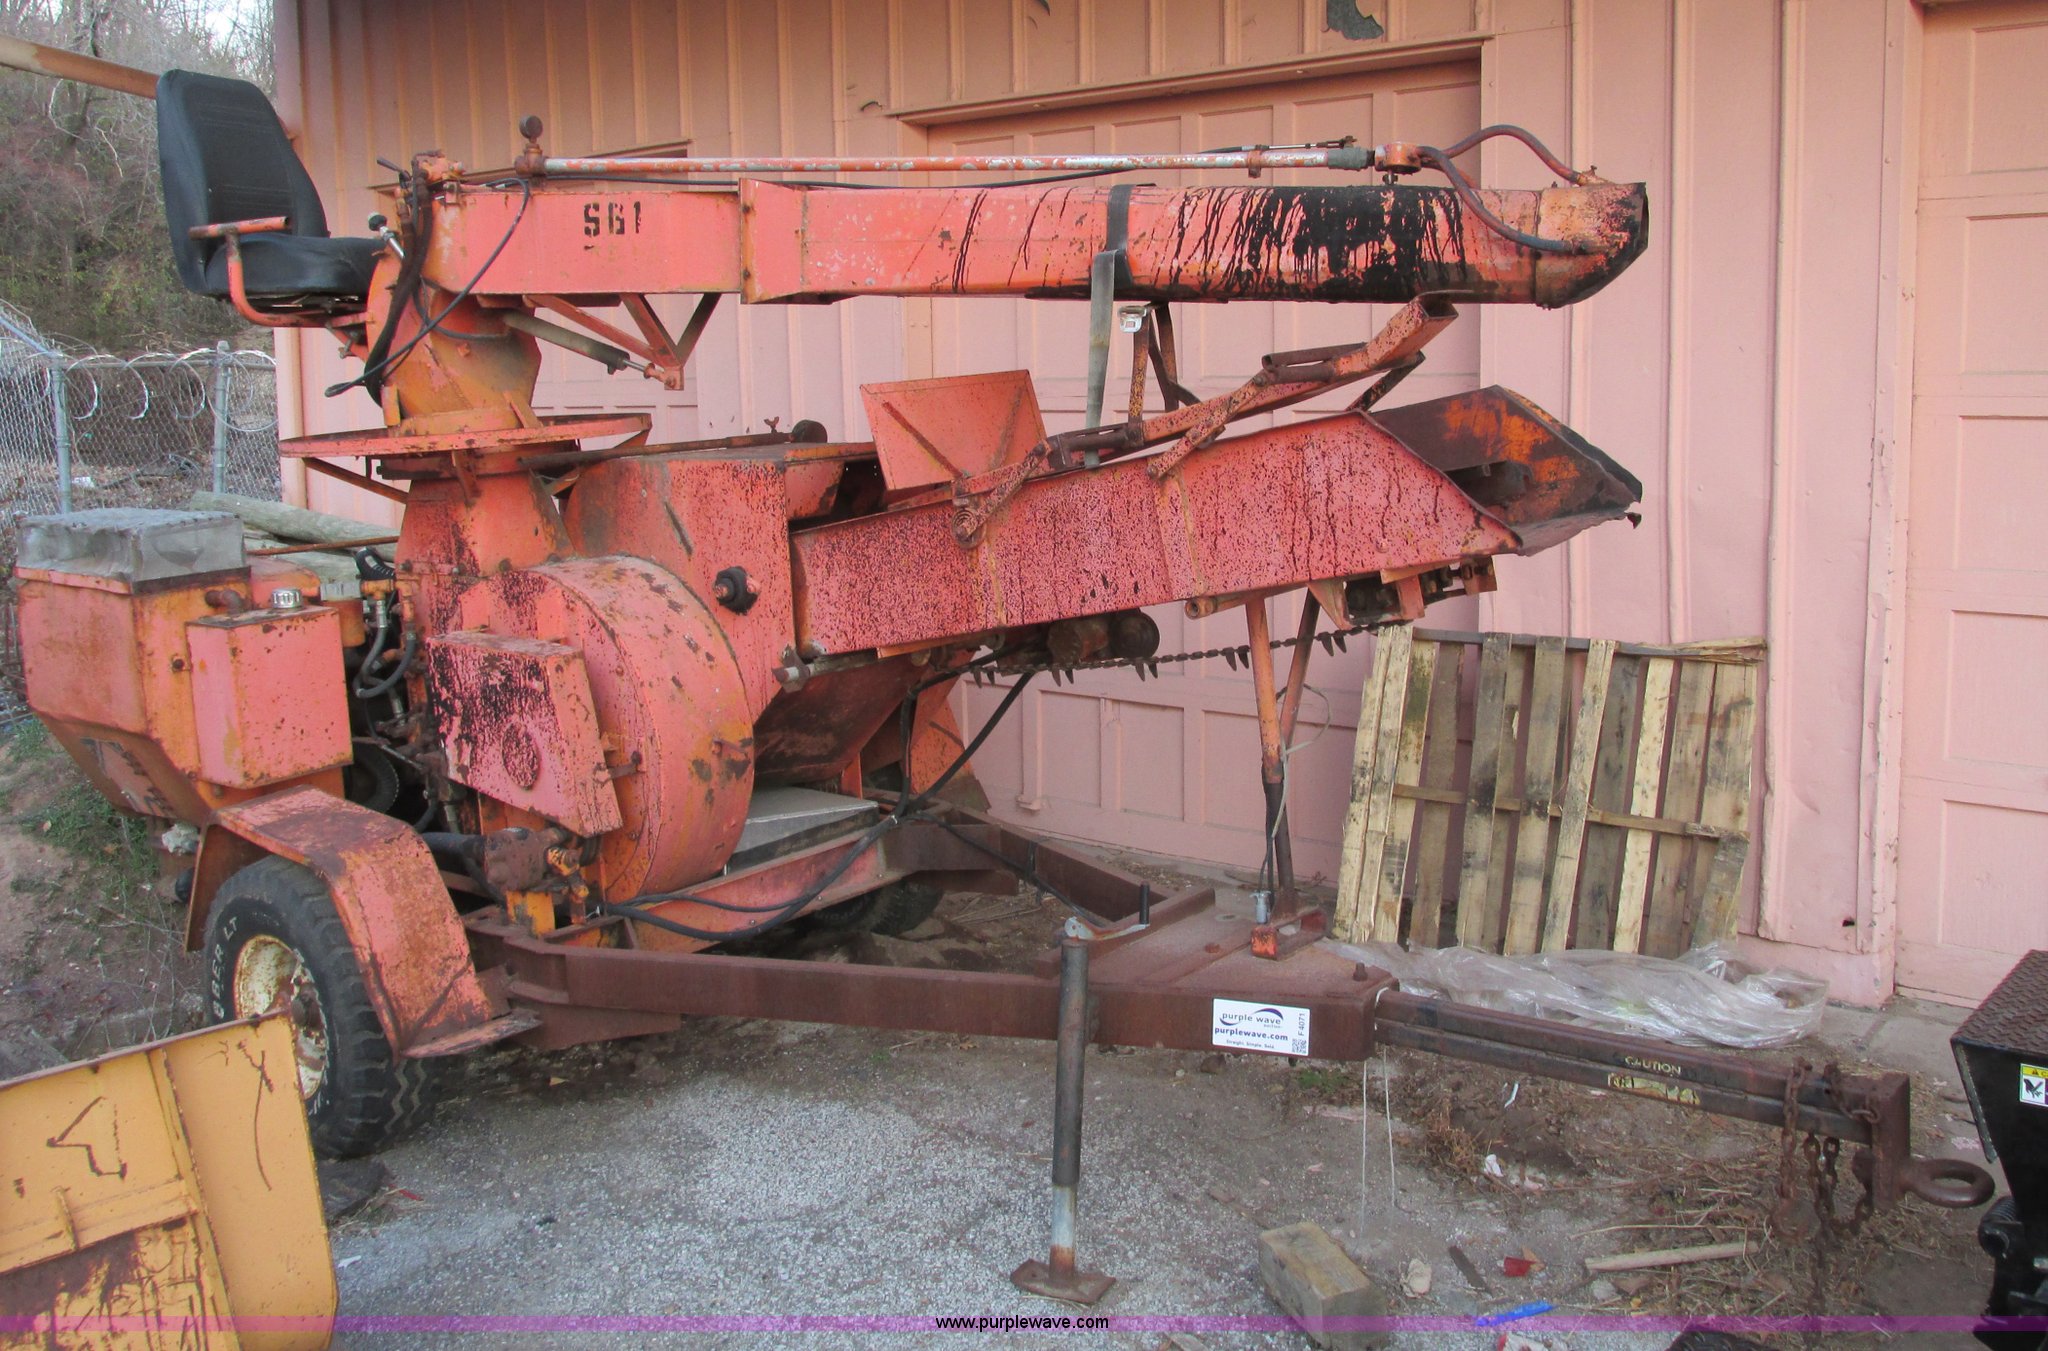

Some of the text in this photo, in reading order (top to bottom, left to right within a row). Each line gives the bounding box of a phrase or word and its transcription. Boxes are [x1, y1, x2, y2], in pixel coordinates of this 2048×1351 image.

[1222, 1012, 1281, 1025] purple wave
[1215, 1027, 1288, 1041] purplewave.com
[1625, 1056, 1681, 1075] CAUTION
